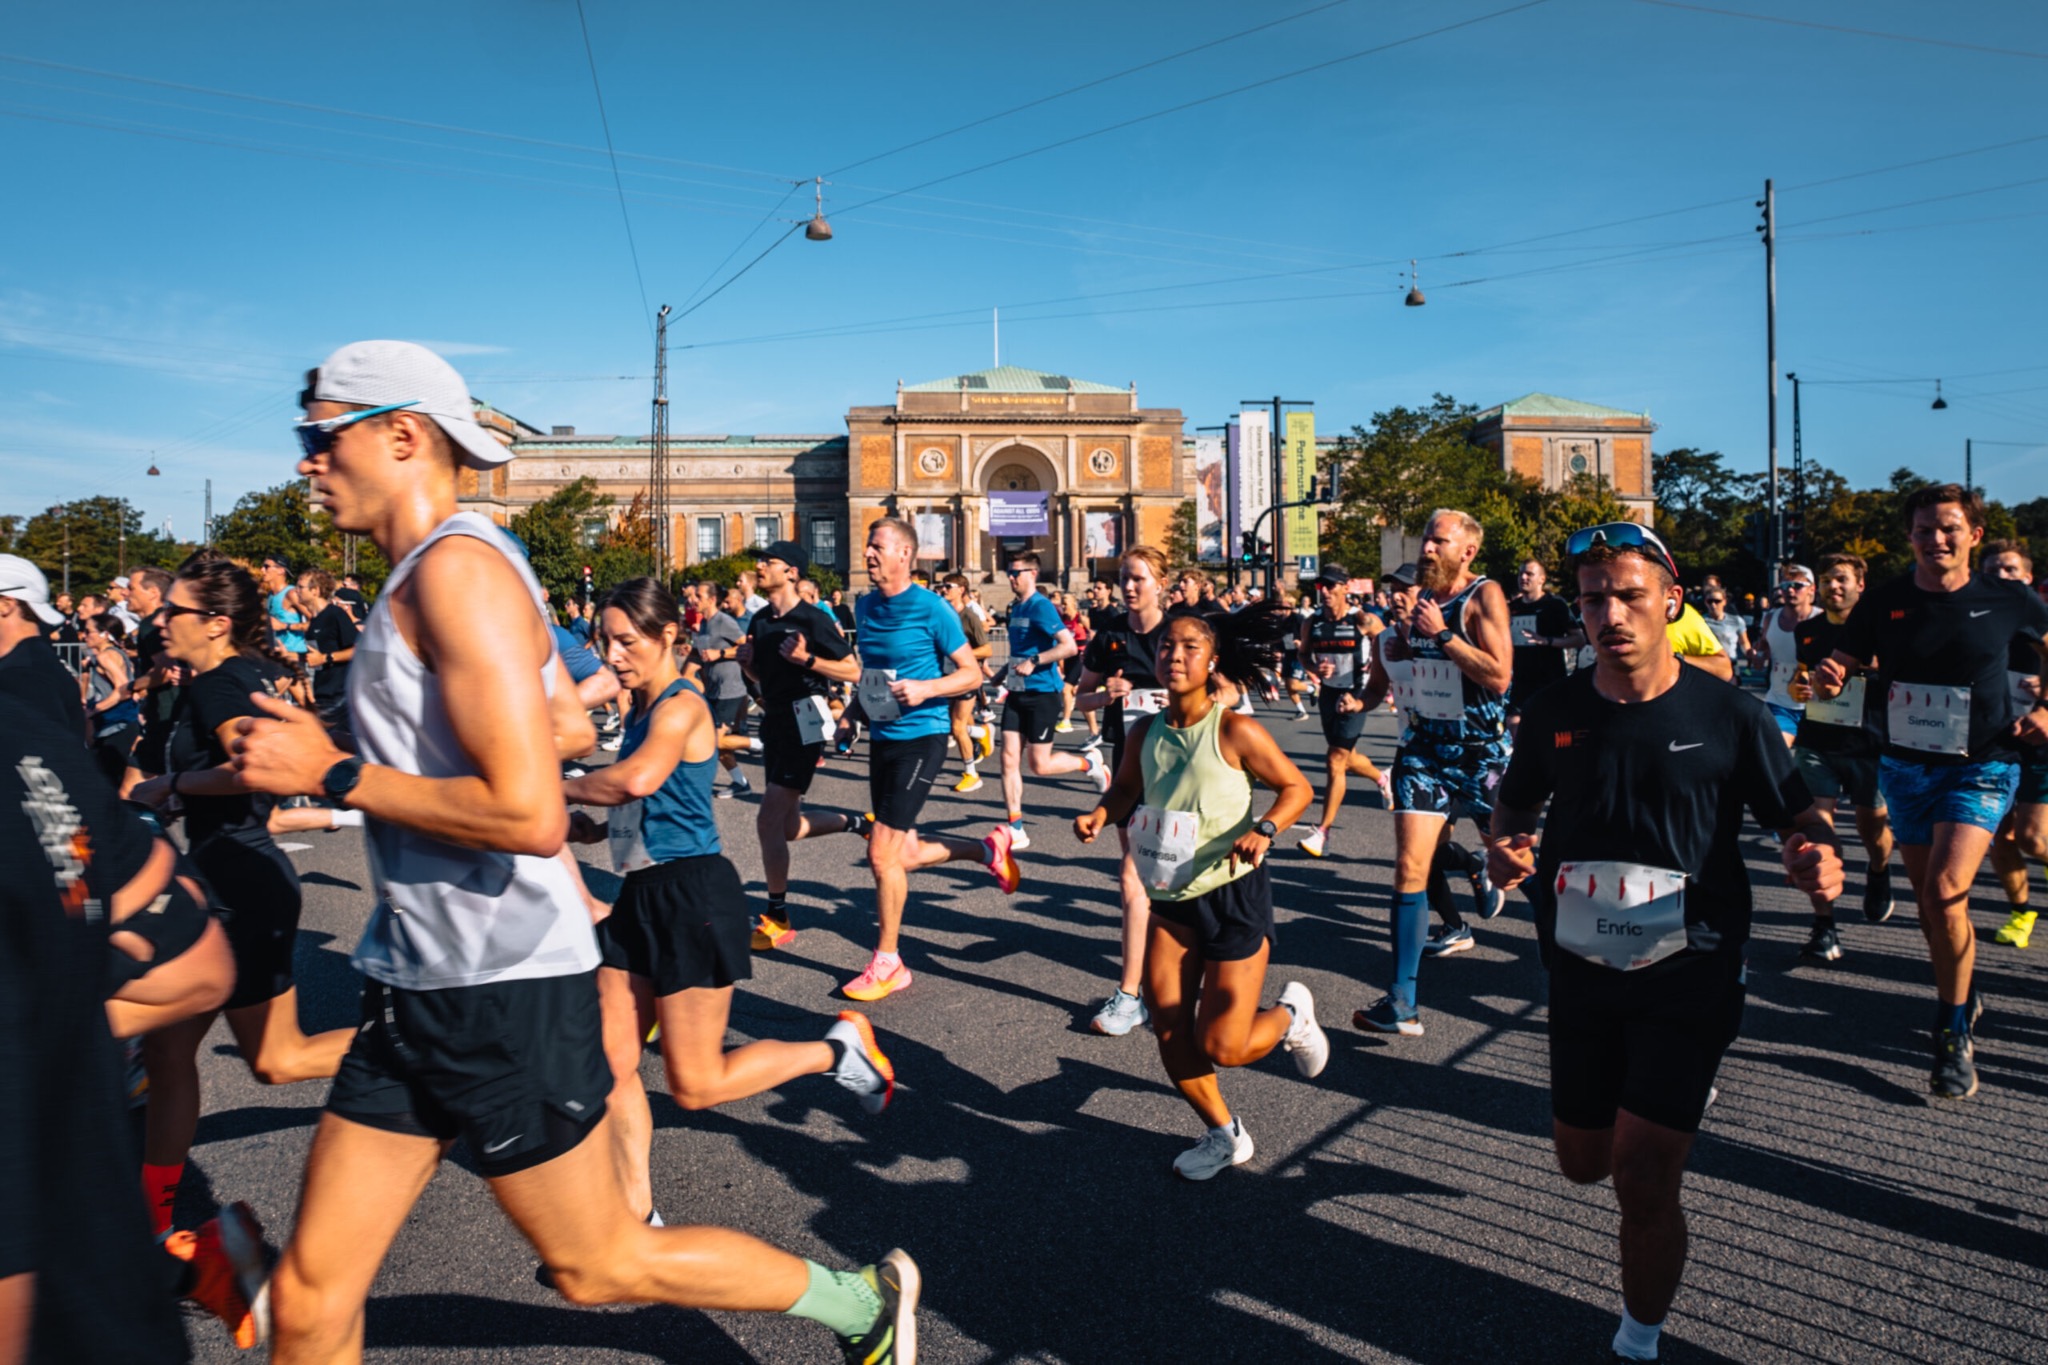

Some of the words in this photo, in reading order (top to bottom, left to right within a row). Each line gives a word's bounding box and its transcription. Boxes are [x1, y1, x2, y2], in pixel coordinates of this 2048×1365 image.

[1296, 440, 1306, 521] Parkmuseene
[1907, 715, 1945, 729] Simon
[1137, 843, 1178, 862] Vanessa
[1596, 917, 1644, 937] Enric
